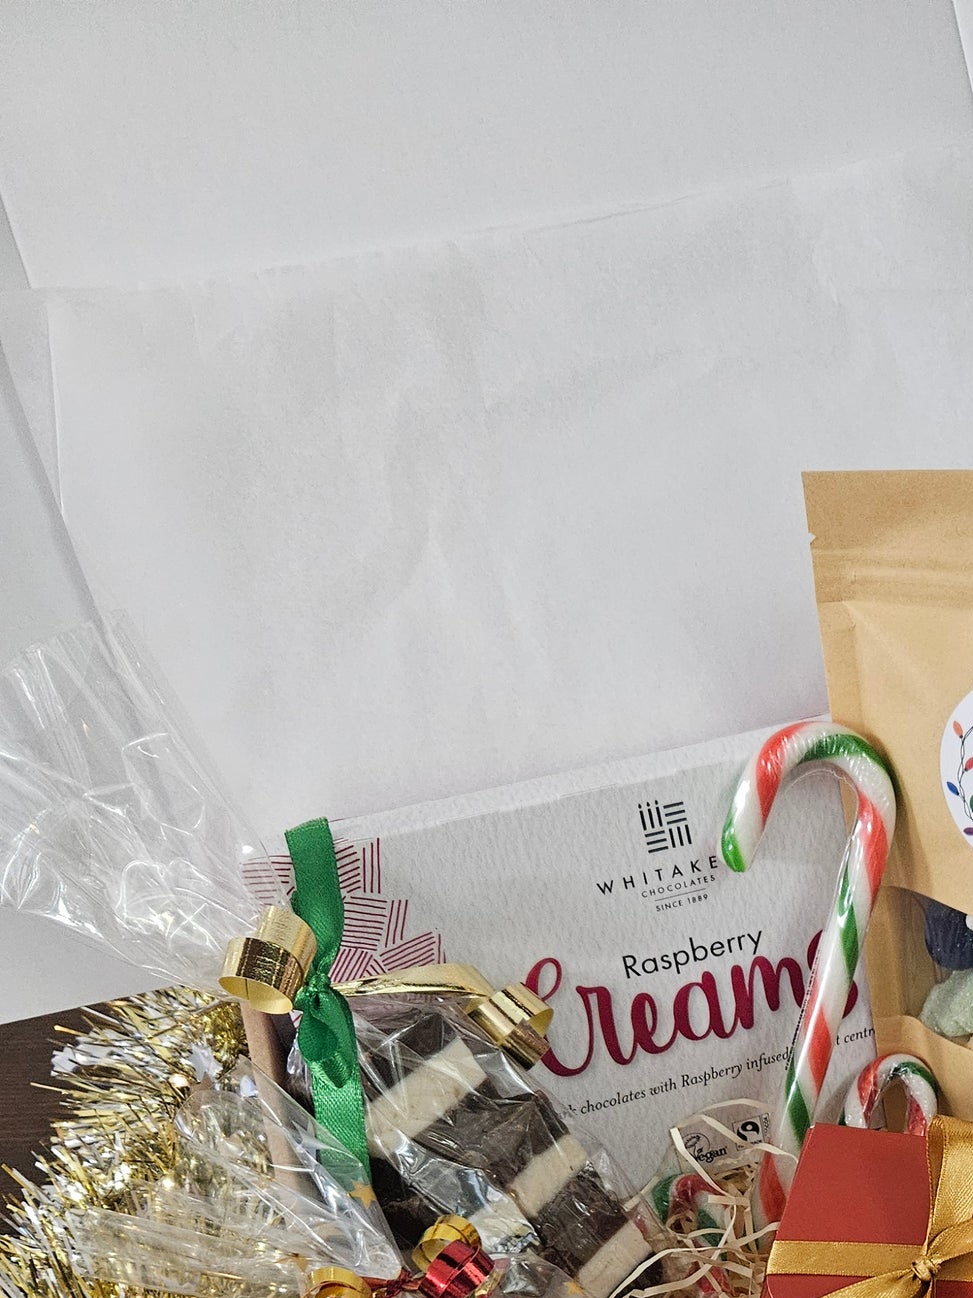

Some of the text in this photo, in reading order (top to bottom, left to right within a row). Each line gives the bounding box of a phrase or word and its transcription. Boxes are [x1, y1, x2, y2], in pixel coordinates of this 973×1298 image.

[641, 875, 716, 898] CHOCOLATES
[656, 894, 709, 912] SINCE 1889
[622, 930, 763, 979] Raspberry
[580, 1092, 646, 1116] chocolates
[649, 1078, 677, 1096] with
[681, 1062, 743, 1088] Raspberry
[746, 1046, 790, 1072] infused
